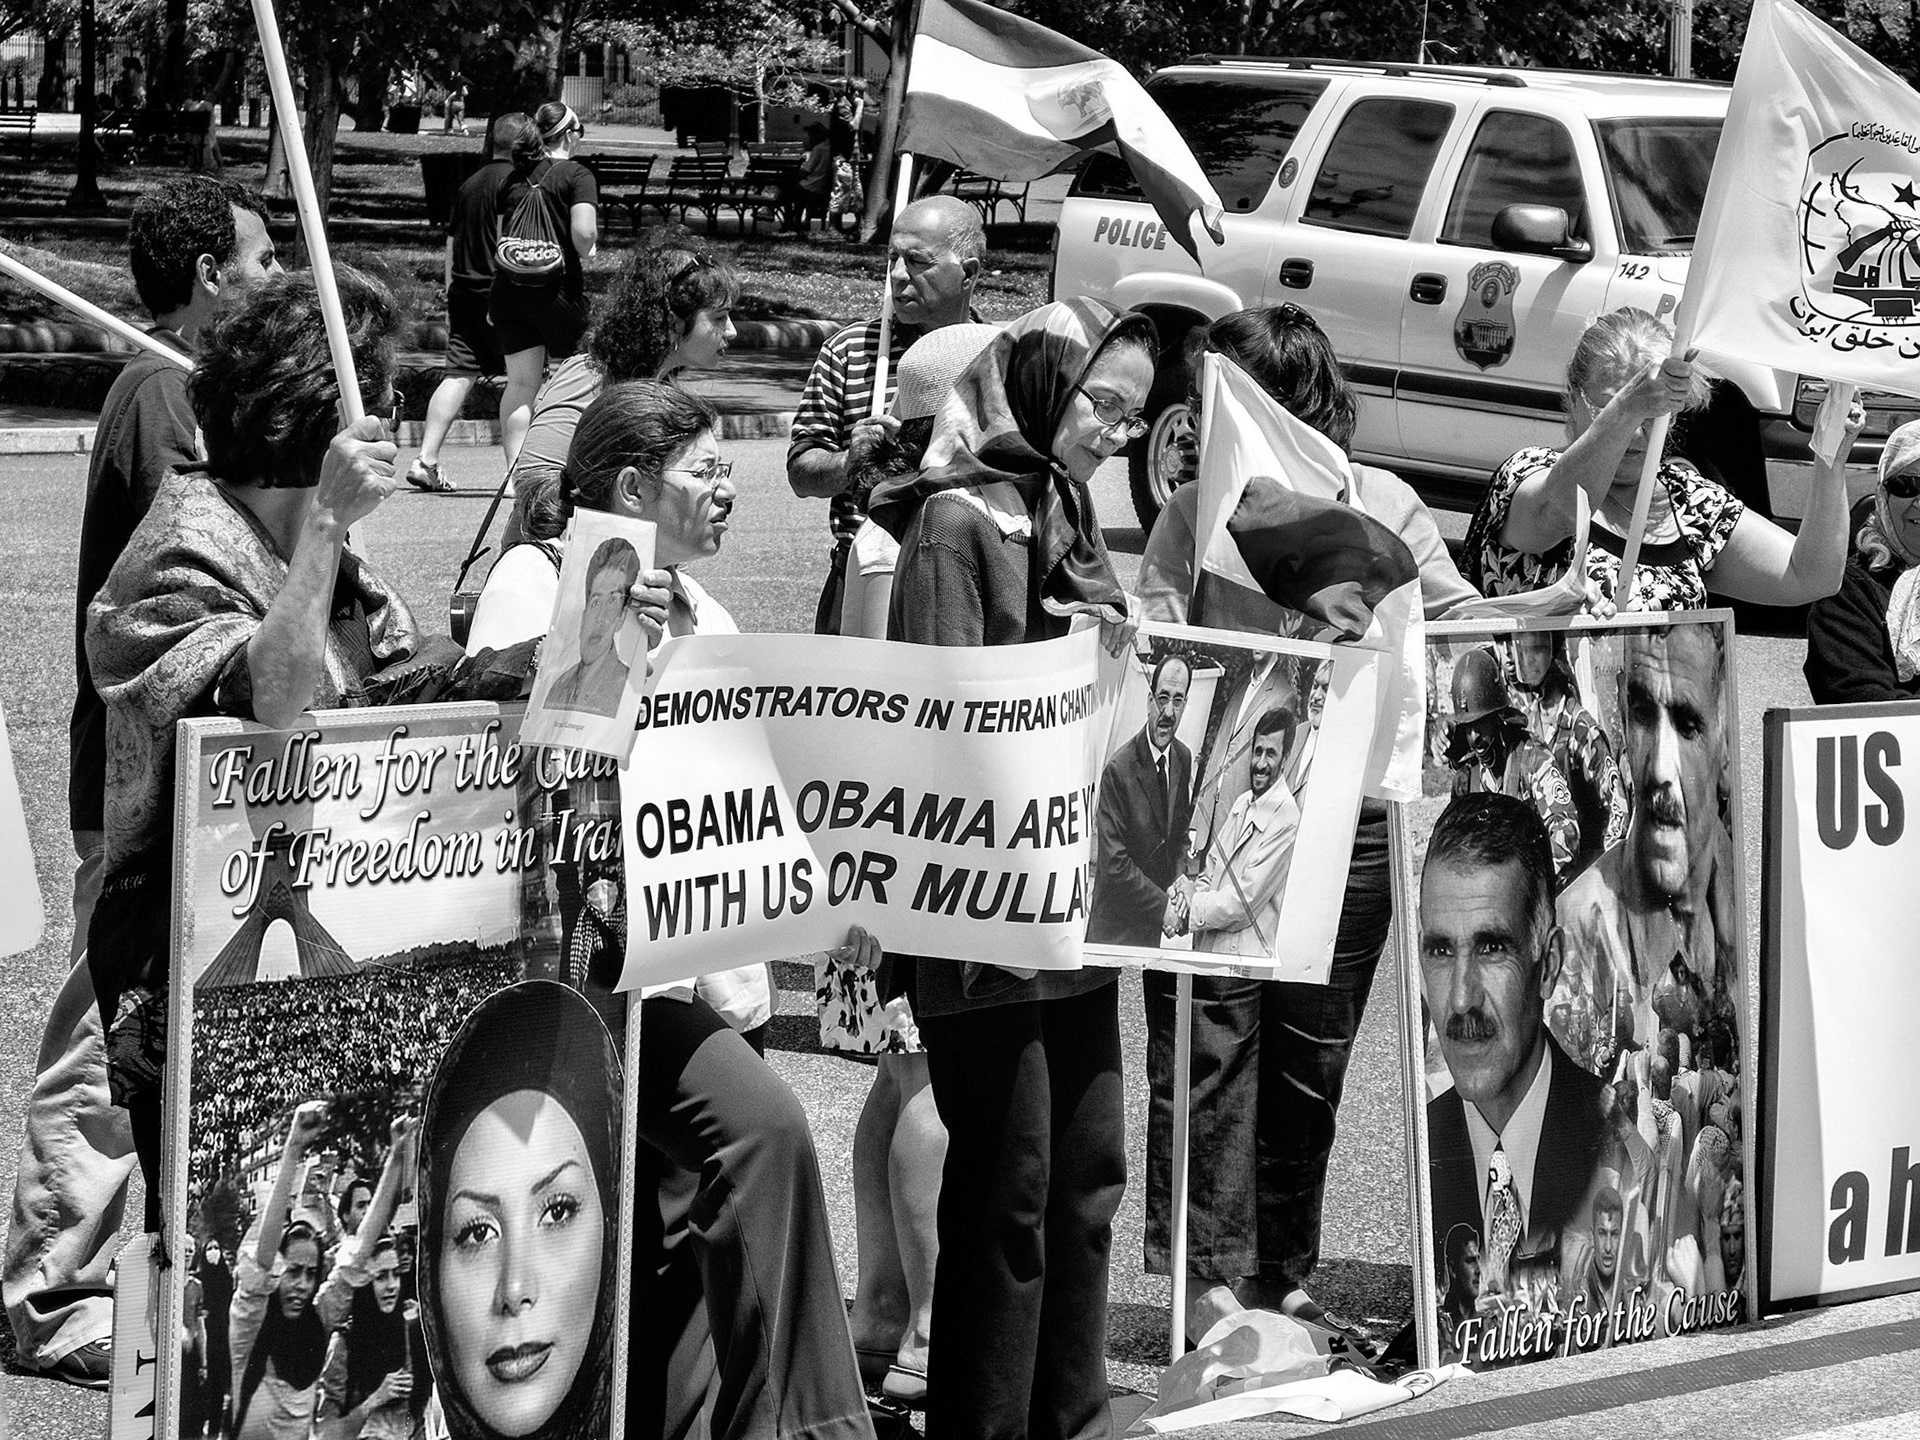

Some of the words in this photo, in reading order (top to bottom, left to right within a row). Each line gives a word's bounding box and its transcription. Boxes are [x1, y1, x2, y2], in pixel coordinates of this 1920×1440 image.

[1094, 216, 1169, 252] POLICE
[1618, 261, 1650, 280] 142
[634, 685, 909, 731] DEMONSTRATORS
[914, 698, 955, 731] IN
[963, 694, 1057, 733] TEHRAN
[209, 730, 361, 808] Fallen
[360, 726, 447, 820] for
[454, 720, 521, 791] the
[1815, 731, 1905, 850] US
[636, 785, 784, 859] OBAMA
[796, 780, 996, 849] OBAMA
[1006, 791, 1079, 850] ARE
[220, 821, 285, 917] of
[288, 811, 483, 888] Freedom
[495, 809, 538, 871] in
[643, 868, 746, 942] WITH
[762, 858, 814, 920] US
[827, 850, 898, 907] OR
[1455, 1302, 1554, 1366] Fallen
[1562, 1296, 1607, 1359] for
[1613, 1286, 1656, 1343] the
[1663, 1286, 1739, 1338] Cause
